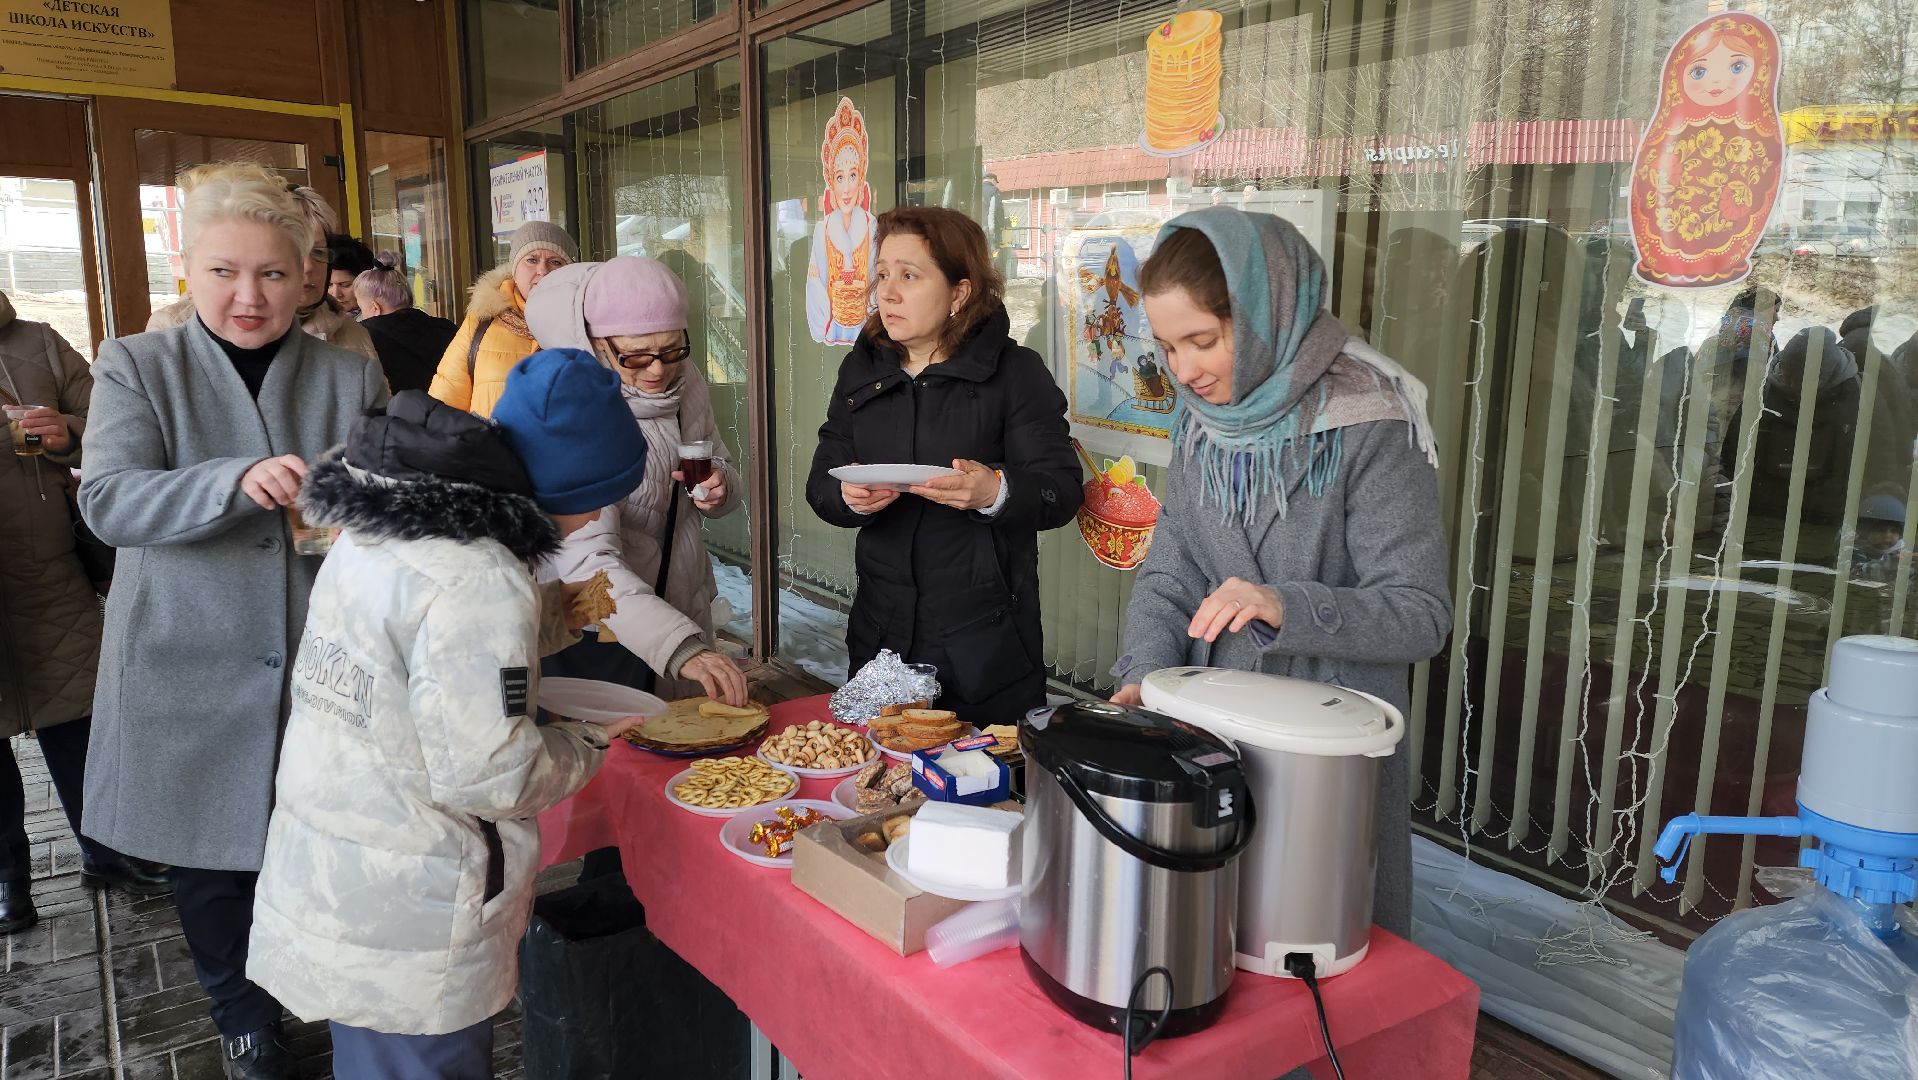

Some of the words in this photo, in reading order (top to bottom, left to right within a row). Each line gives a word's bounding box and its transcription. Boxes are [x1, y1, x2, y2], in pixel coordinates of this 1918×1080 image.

[43, 0, 120, 18] «ДЕТСКАЯ
[8, 11, 68, 29] ШКОЛА
[71, 19, 155, 39] ИСКУССТВ»
